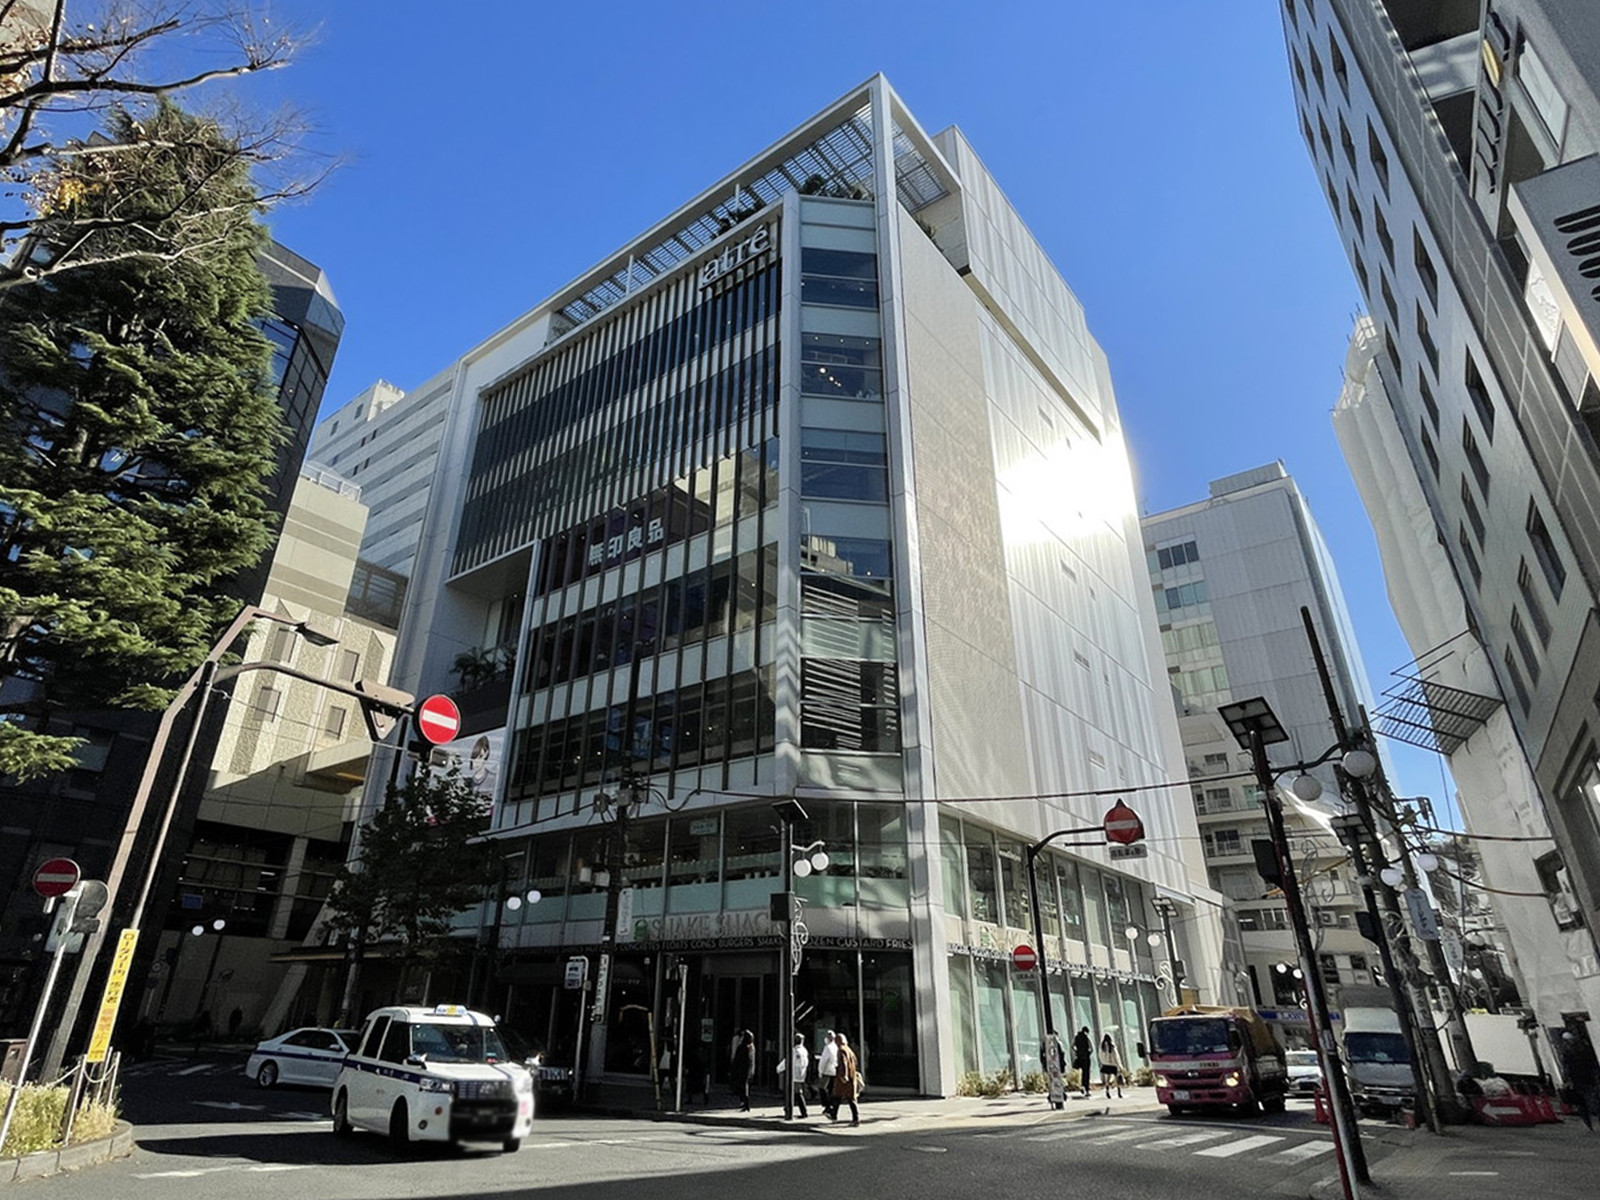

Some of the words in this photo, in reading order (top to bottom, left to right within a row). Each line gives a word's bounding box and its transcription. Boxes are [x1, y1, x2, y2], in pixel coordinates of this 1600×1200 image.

[703, 225, 769, 284] atré
[589, 518, 664, 565] 無印良品
[651, 914, 710, 941] SHAKE
[719, 936, 754, 948] BURGERS
[757, 935, 786, 947] SHAKE
[836, 938, 883, 948] CUSTARD
[885, 939, 914, 950] FRIES
